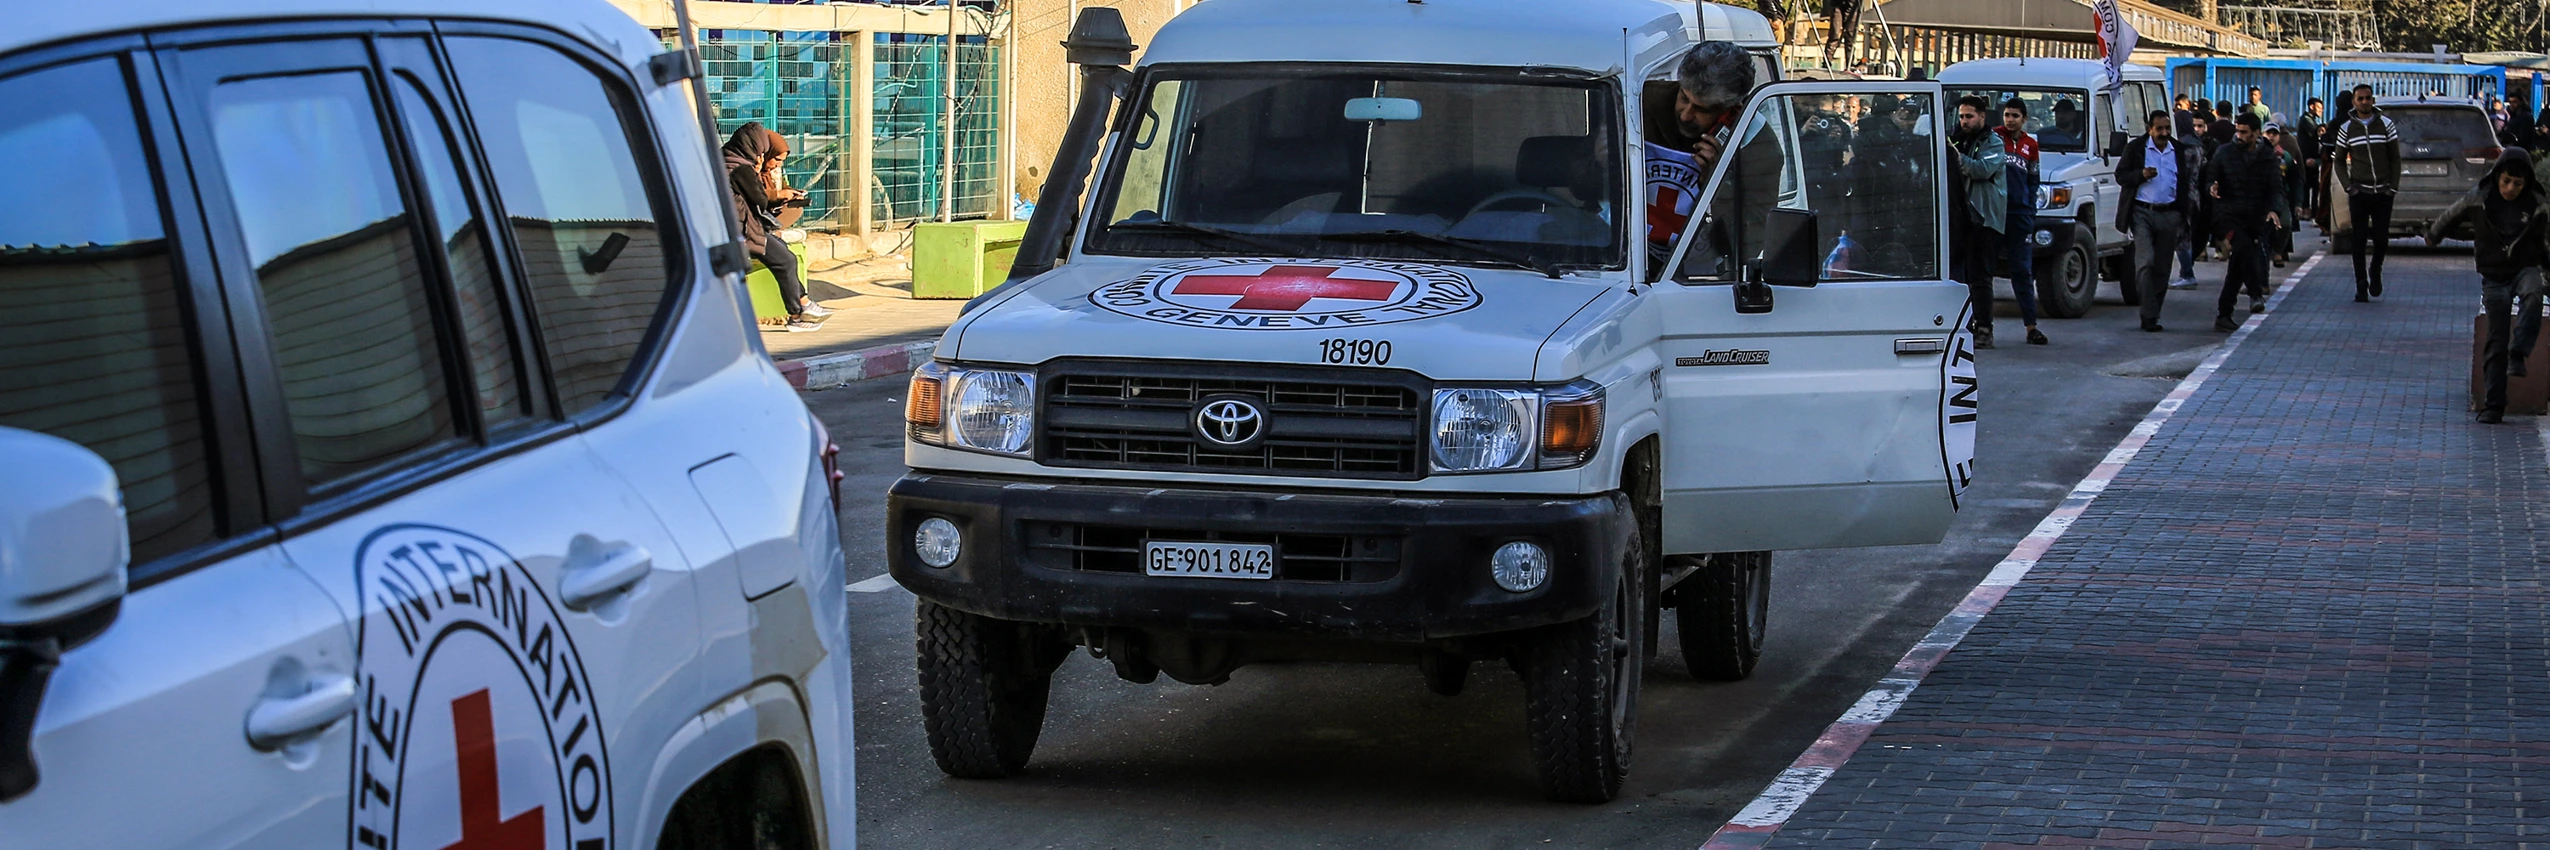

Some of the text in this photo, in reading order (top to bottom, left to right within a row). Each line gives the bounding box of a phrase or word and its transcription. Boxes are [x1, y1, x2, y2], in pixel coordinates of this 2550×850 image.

[1145, 307, 1377, 327] GENEVE
[1318, 338, 1393, 366] 18190
[1949, 312, 1978, 424] INT
[376, 541, 604, 850] INTERNATIO
